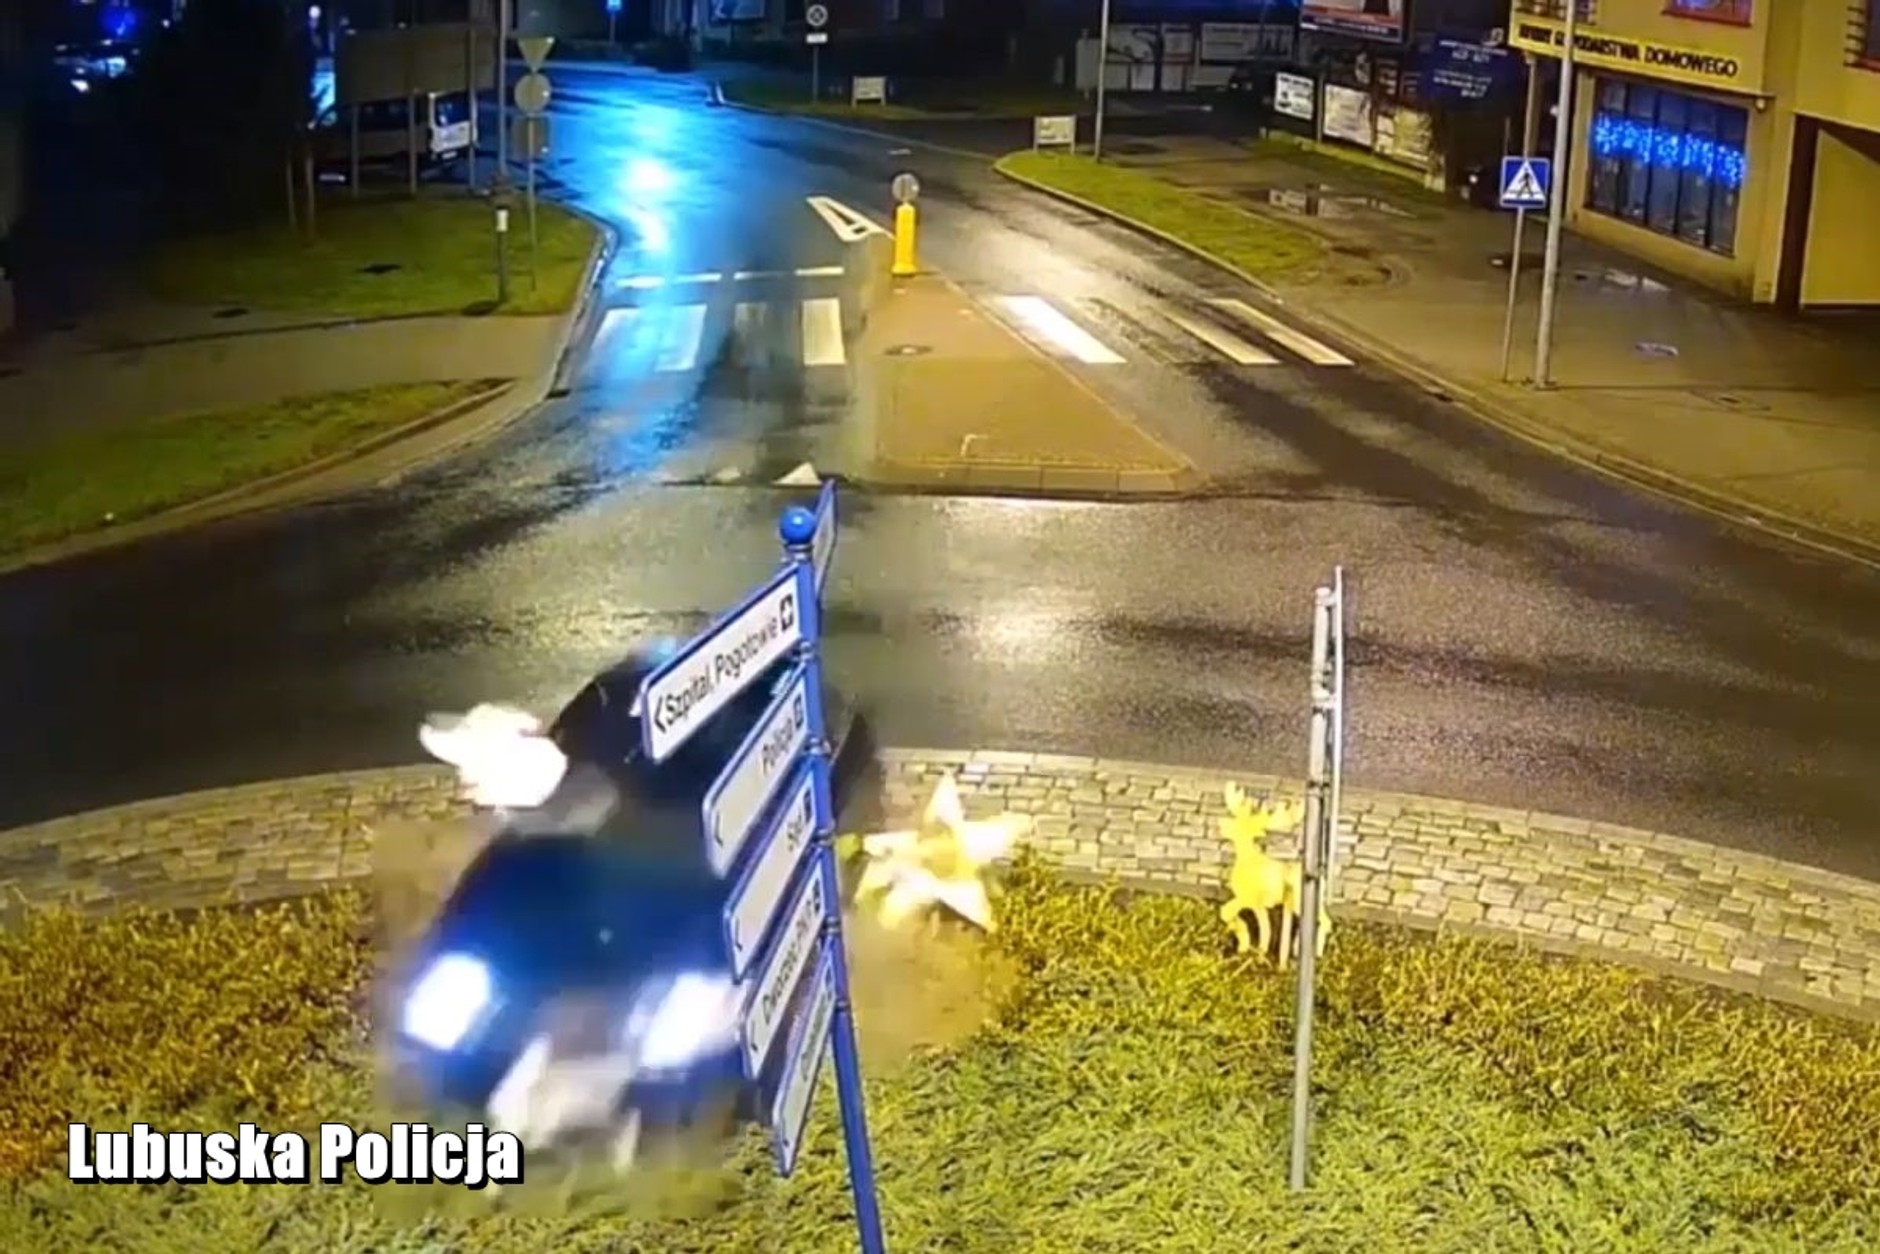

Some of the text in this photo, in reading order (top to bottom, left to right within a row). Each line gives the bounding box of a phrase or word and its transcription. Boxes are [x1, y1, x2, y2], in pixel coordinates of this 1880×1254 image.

[1645, 46, 1738, 77] DOMOWEGO
[715, 617, 777, 684] Pogotowie
[762, 718, 793, 776] Policja
